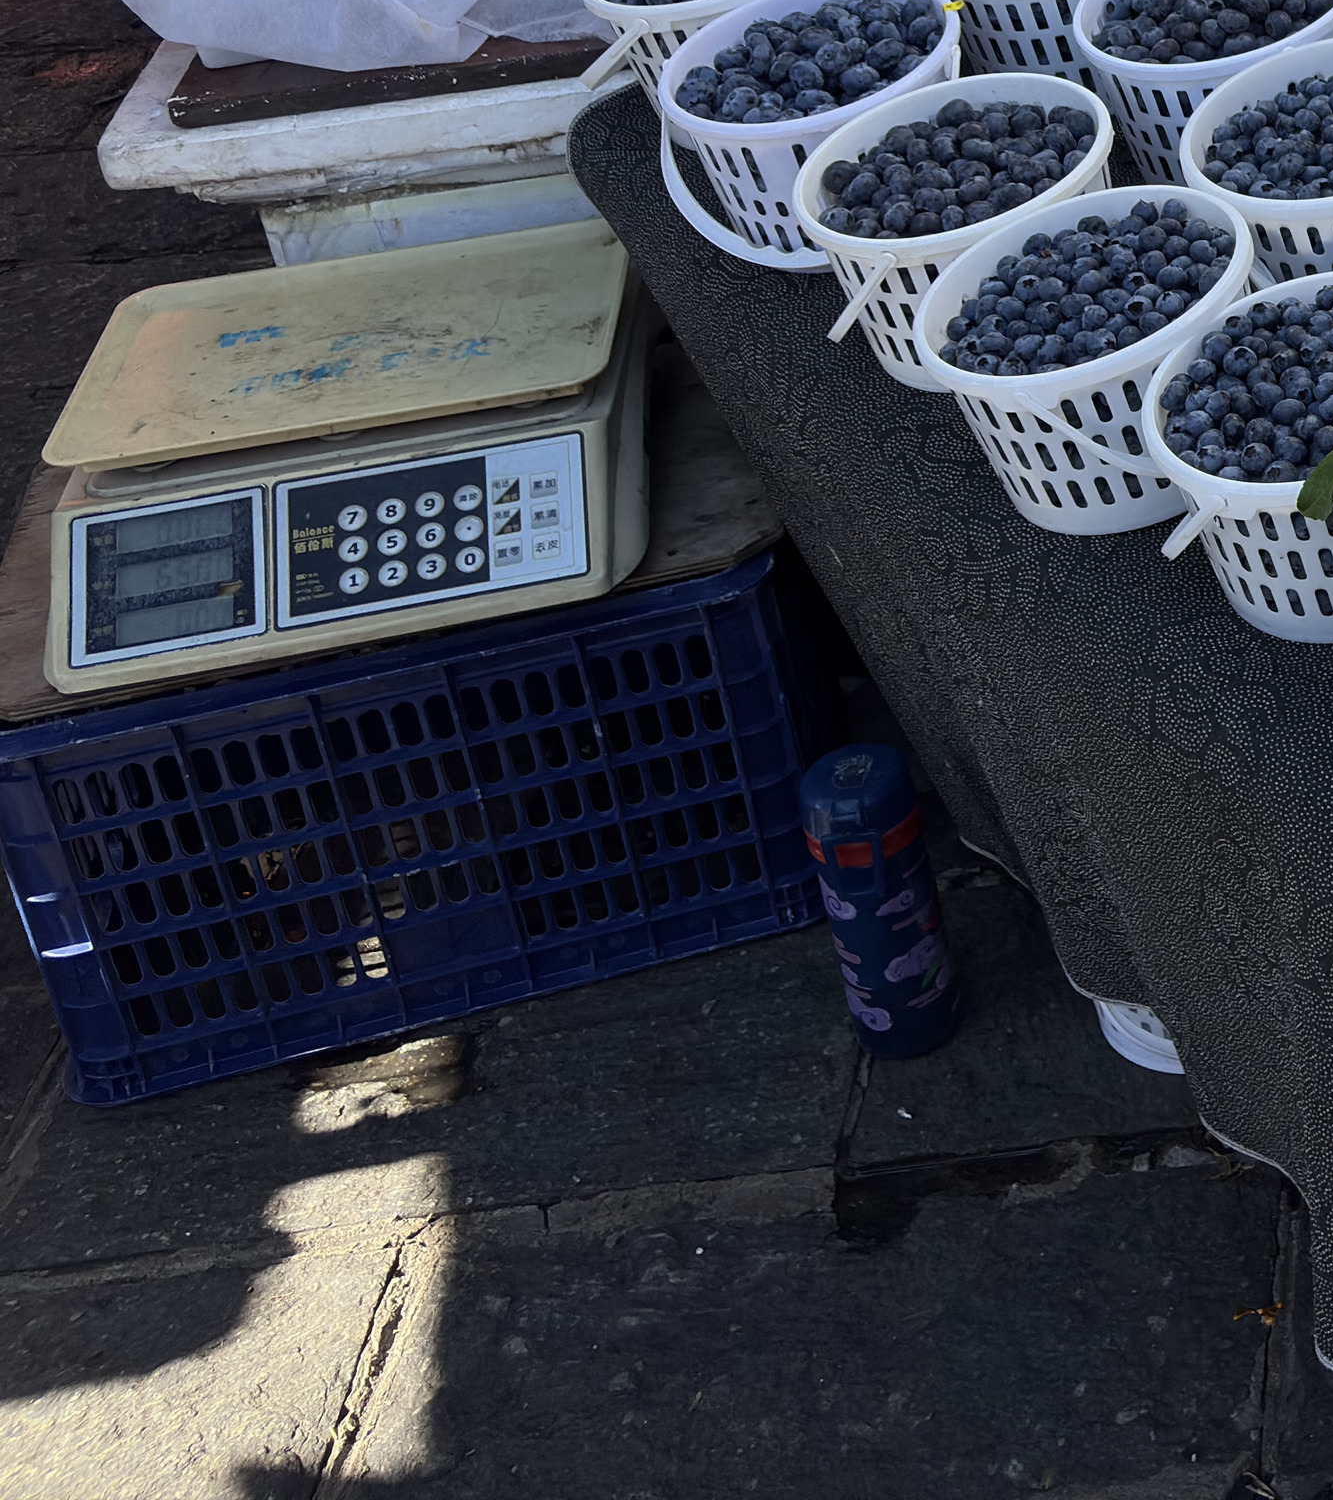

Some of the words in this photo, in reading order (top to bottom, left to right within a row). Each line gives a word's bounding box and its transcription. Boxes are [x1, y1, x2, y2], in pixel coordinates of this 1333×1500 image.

[385, 504, 398, 518] 8
[423, 498, 435, 512] 9
[347, 511, 358, 525] 7
[292, 525, 335, 540] Balance
[424, 528, 436, 542] 6
[347, 542, 359, 555] 4
[386, 535, 398, 549] 5
[535, 539, 559, 553] 去皮
[425, 560, 438, 573] 3
[464, 553, 476, 567] 0
[348, 573, 360, 588] 1
[387, 567, 399, 581] 2
